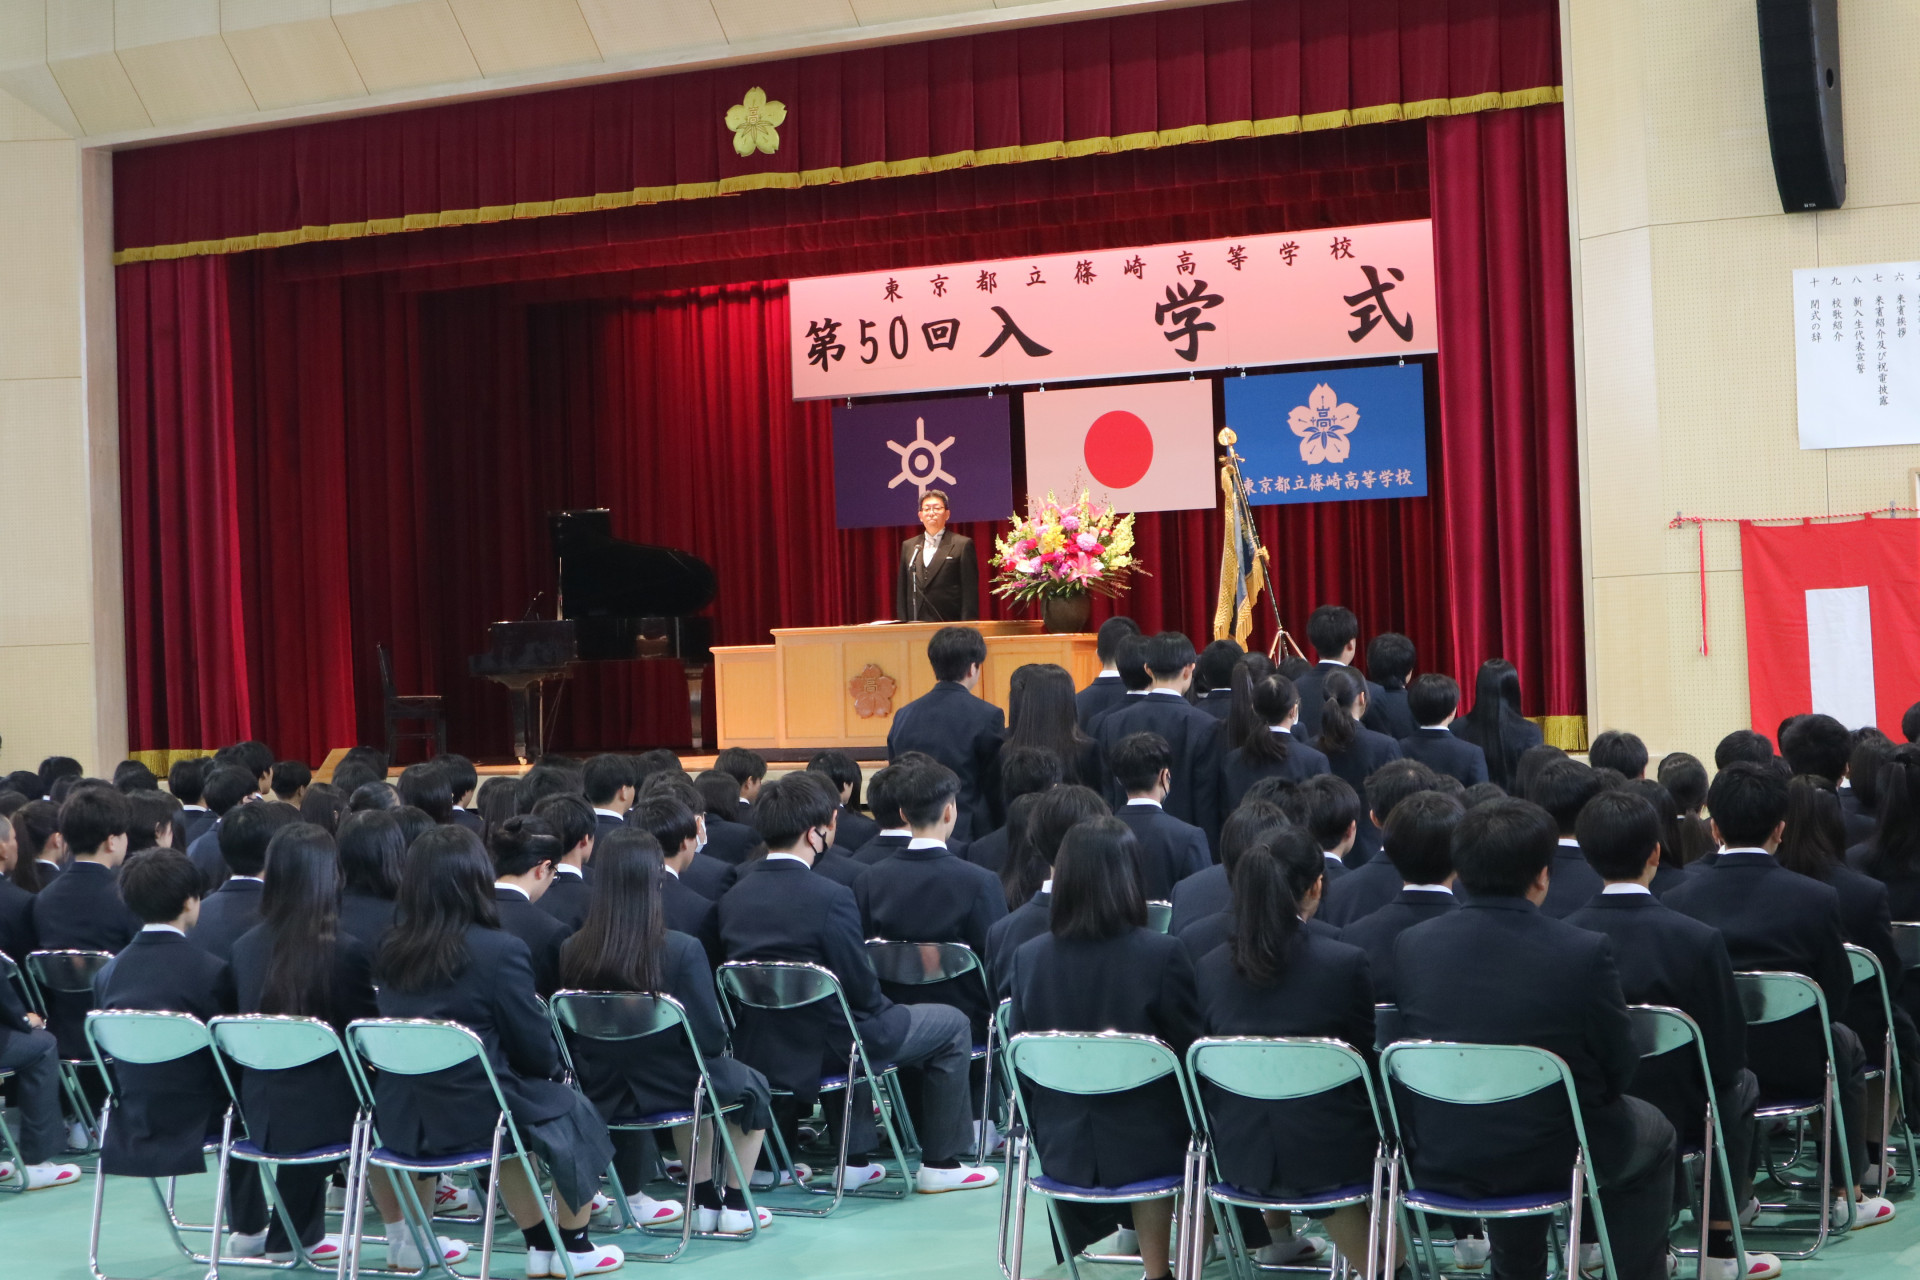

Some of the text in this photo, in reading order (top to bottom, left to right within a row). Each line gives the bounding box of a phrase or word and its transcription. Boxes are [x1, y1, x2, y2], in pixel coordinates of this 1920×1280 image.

[882, 236, 1356, 303] 東京都立篠崎高等学校
[1810, 277, 1820, 288] 十
[1873, 273, 1883, 283] 七
[1894, 272, 1905, 282] 六
[804, 264, 1416, 373] 第50回入学式
[1831, 276, 1843, 342] 九 校歌紹介
[1852, 276, 1866, 374] 八 新入生代表宣誓
[1244, 468, 1414, 496] 東京都立篠崎高等学校
